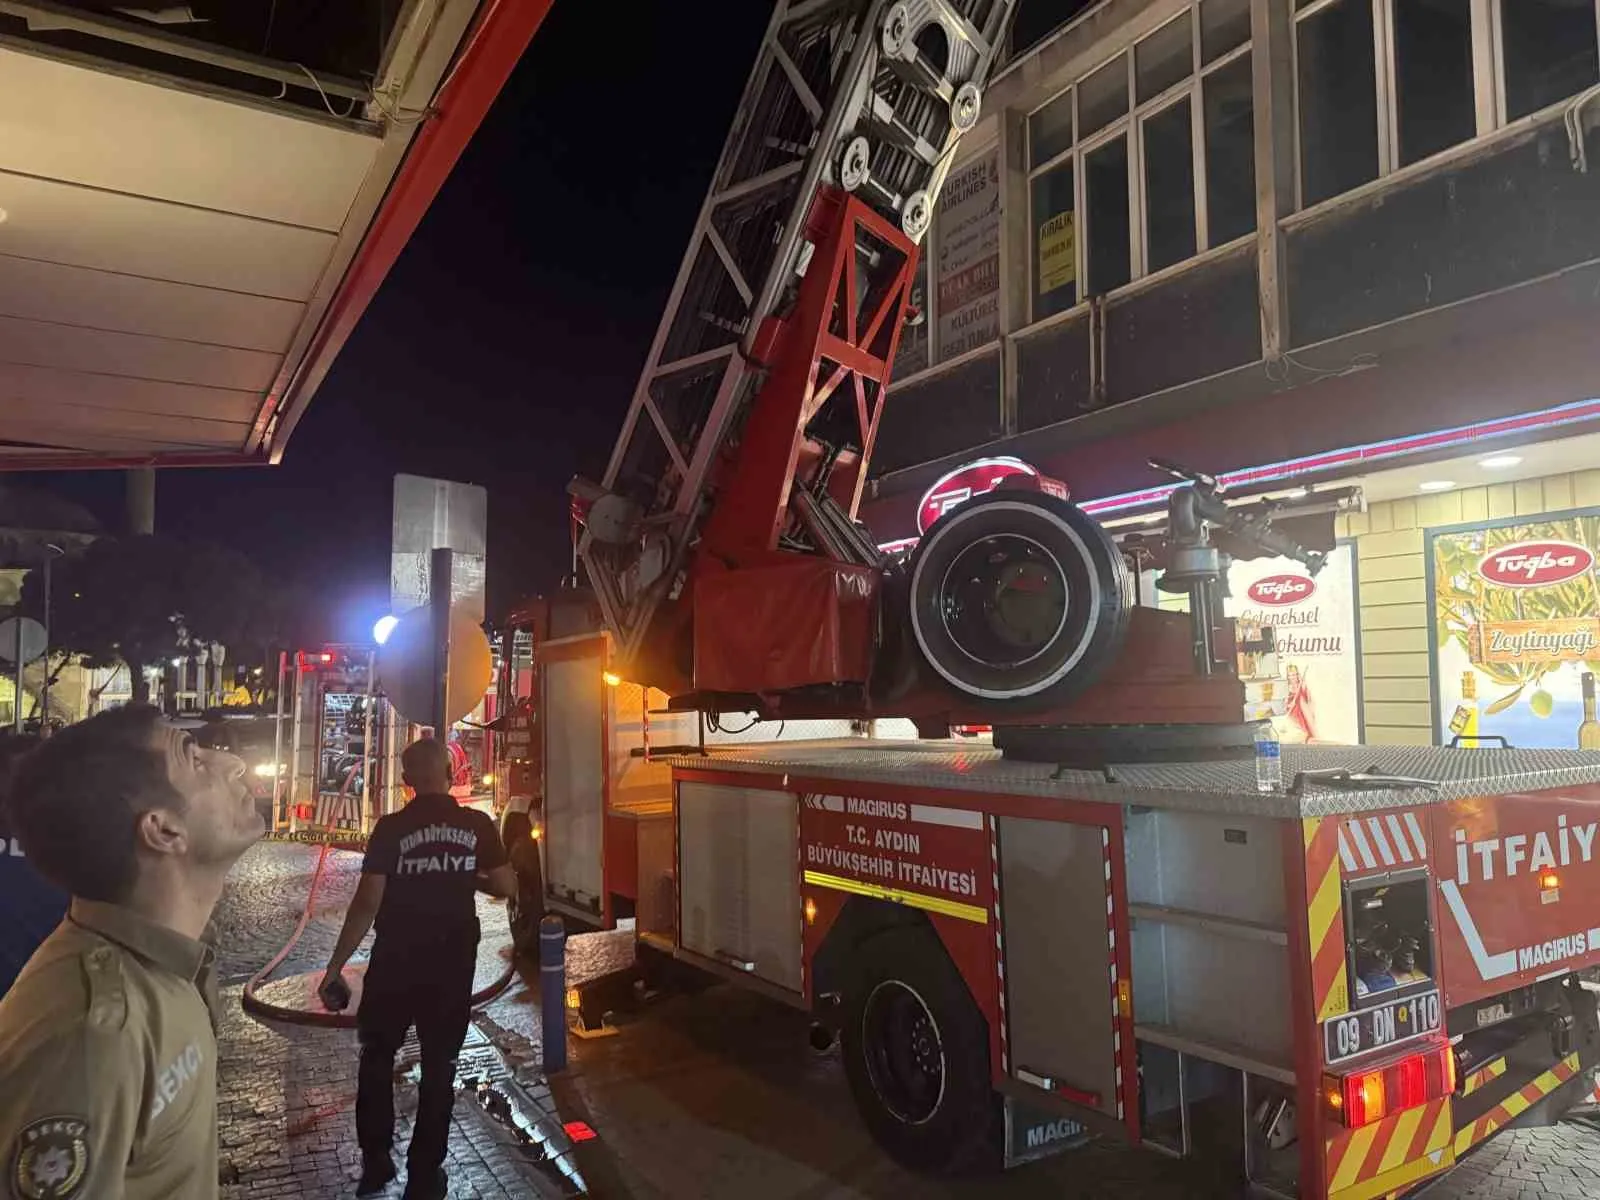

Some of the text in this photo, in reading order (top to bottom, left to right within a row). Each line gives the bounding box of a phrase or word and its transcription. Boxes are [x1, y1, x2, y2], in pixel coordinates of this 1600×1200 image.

[941, 176, 987, 214] AIRLINES
[847, 797, 907, 820] MAGIRUS
[845, 824, 920, 855] T.C. AYDIN
[1455, 814, 1599, 885] İTFAİY
[396, 851, 476, 874] İTFAİYE
[806, 841, 977, 896] BÜYÜKŞEHİR İTFAİYESİ
[1518, 933, 1587, 971] MAGIRUS
[1336, 1017, 1360, 1055] 09
[1372, 1006, 1396, 1046] DN
[1408, 994, 1439, 1034] 110
